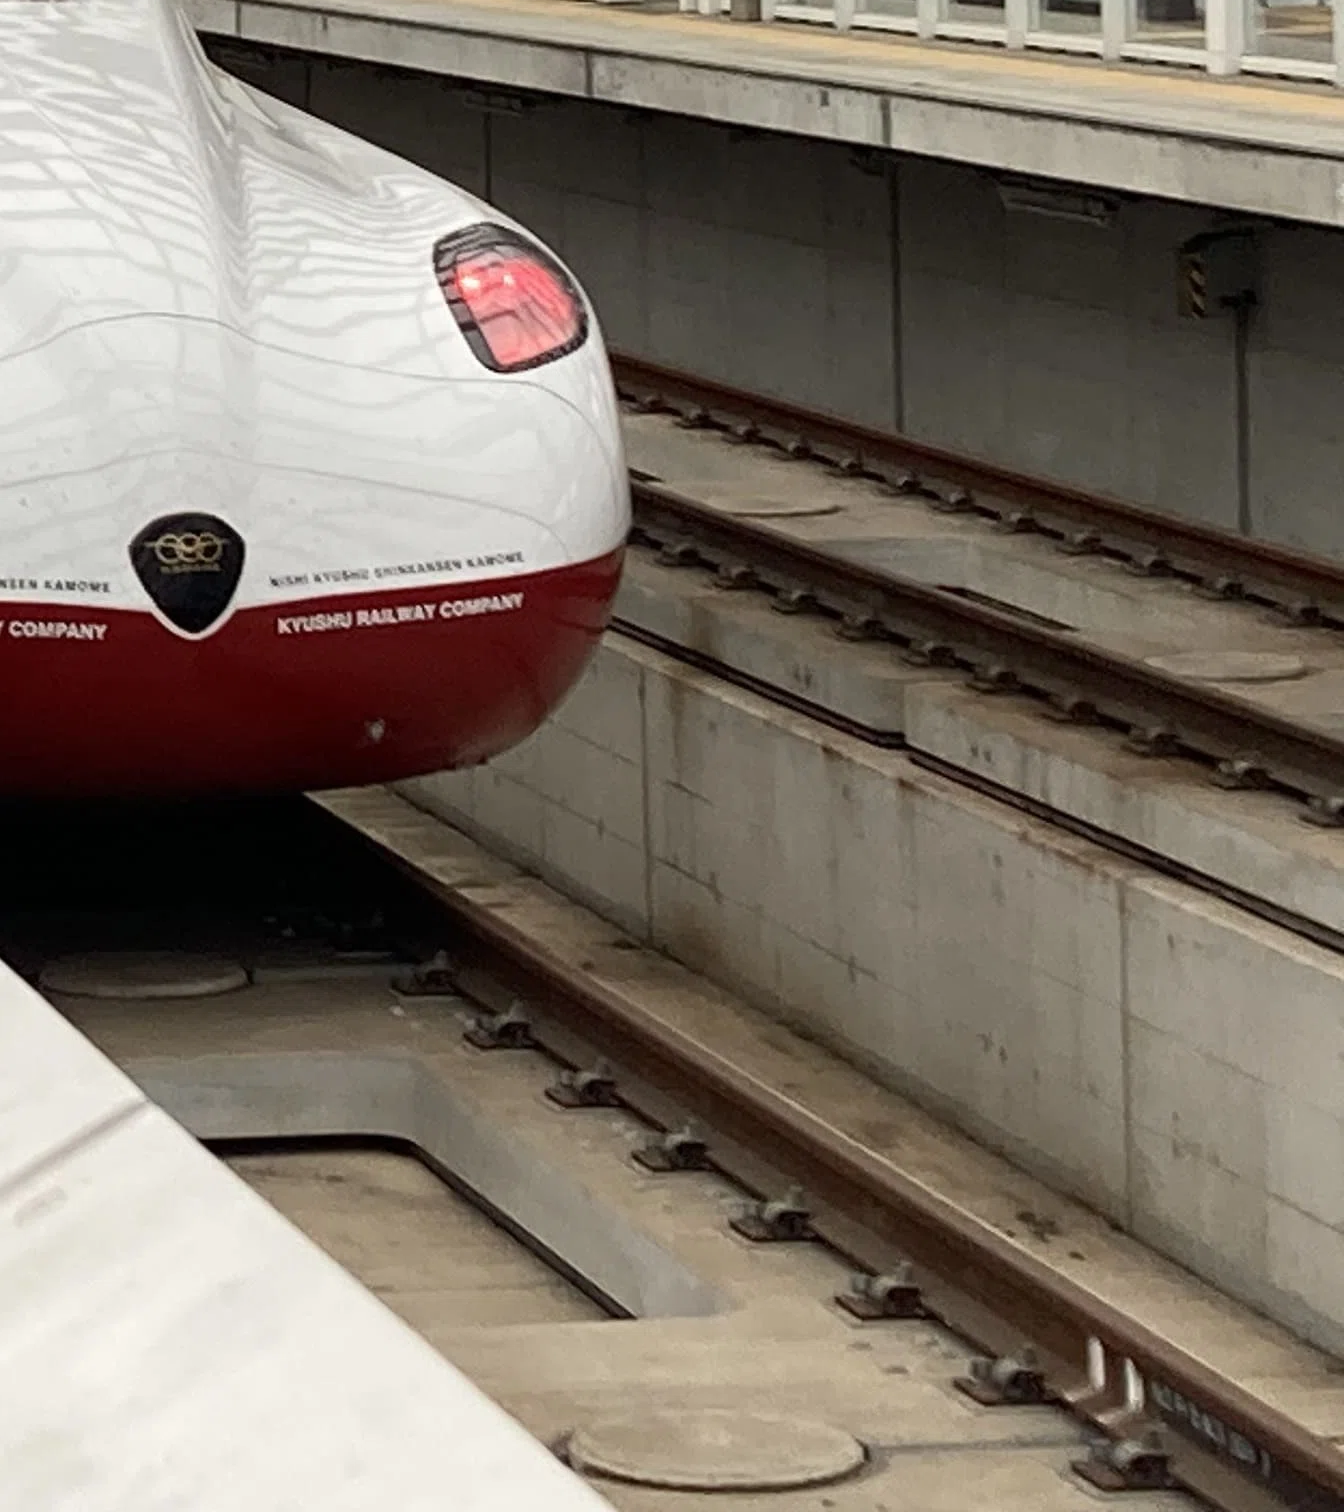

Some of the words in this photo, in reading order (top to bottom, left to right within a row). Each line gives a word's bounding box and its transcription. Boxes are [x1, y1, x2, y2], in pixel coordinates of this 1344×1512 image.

[277, 610, 353, 635] KYUSHU
[356, 603, 436, 626] RAILWAY
[438, 592, 525, 620] COMPANY
[8, 620, 108, 640] COMPANY
